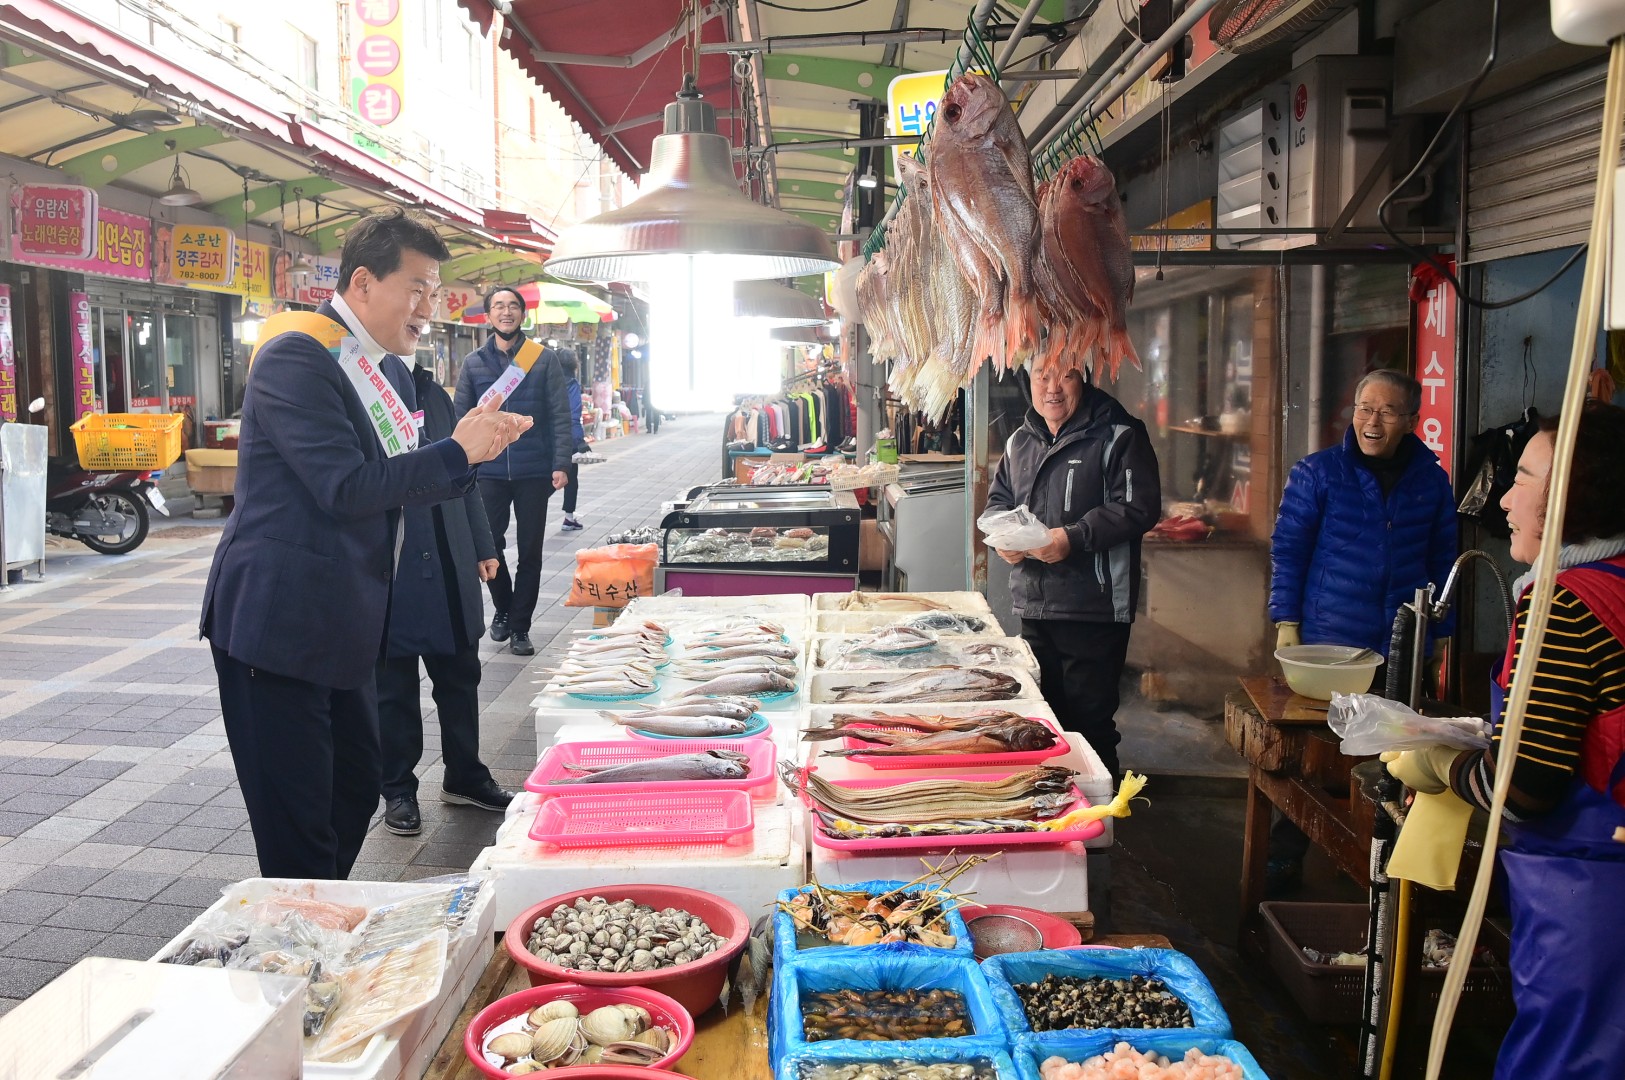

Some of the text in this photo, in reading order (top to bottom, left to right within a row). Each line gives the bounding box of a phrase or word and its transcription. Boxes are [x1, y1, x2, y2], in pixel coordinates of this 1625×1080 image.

[1294, 126, 1306, 148] LG
[34, 198, 69, 219] 유람선
[23, 223, 81, 247] 노래연습장
[180, 232, 222, 248] 소문난
[175, 249, 224, 269] 경주김치
[179, 270, 220, 281] 782-8007
